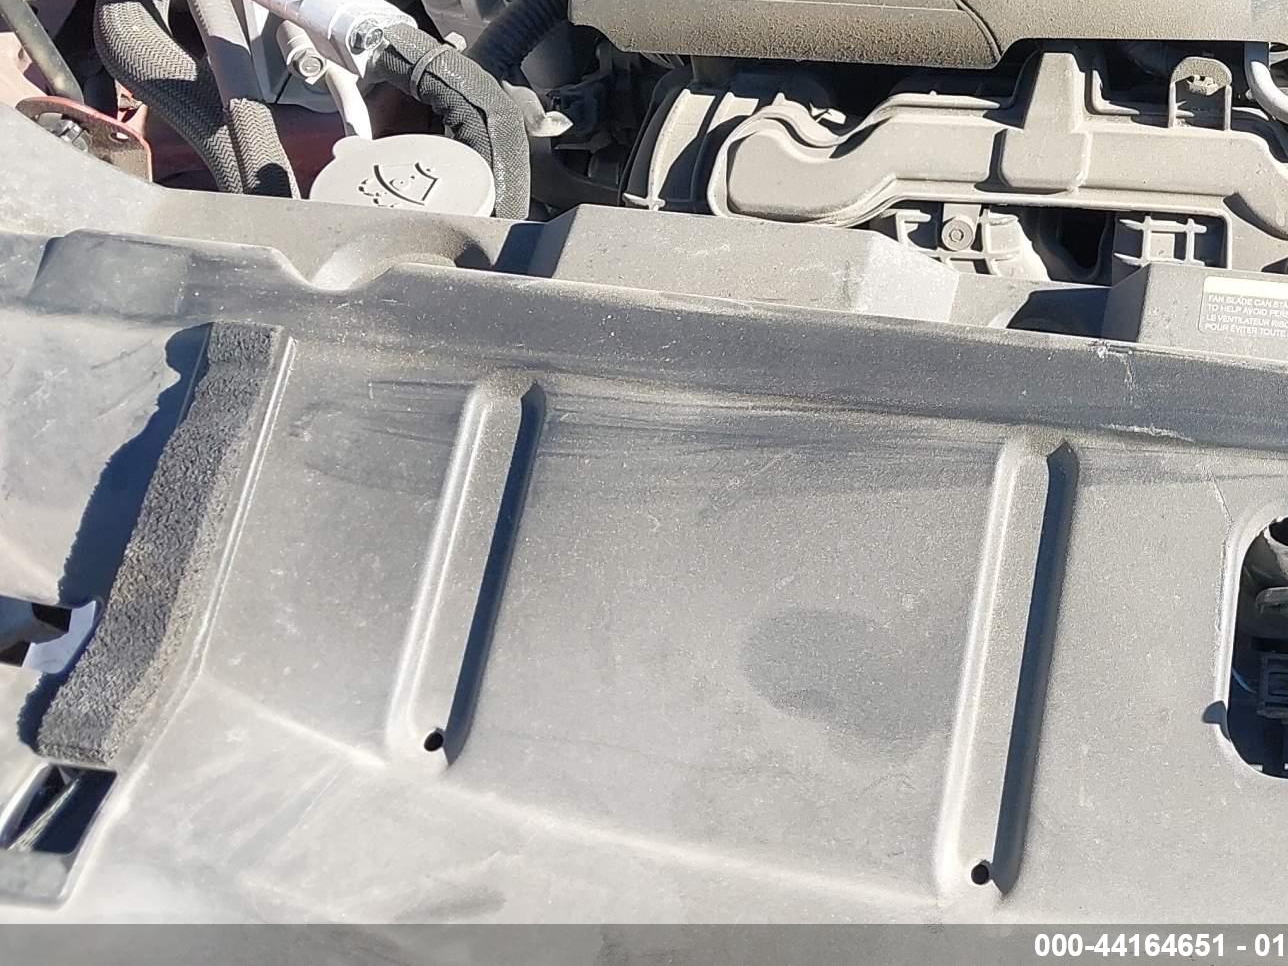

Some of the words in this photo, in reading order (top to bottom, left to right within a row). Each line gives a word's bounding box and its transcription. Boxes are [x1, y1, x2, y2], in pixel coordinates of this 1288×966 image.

[1254, 299, 1272, 308] CAN
[1220, 305, 1241, 315] HELP
[1242, 307, 1268, 317] AVOID
[1218, 315, 1270, 328] VENTILATEUR
[1205, 324, 1228, 333] POUR
